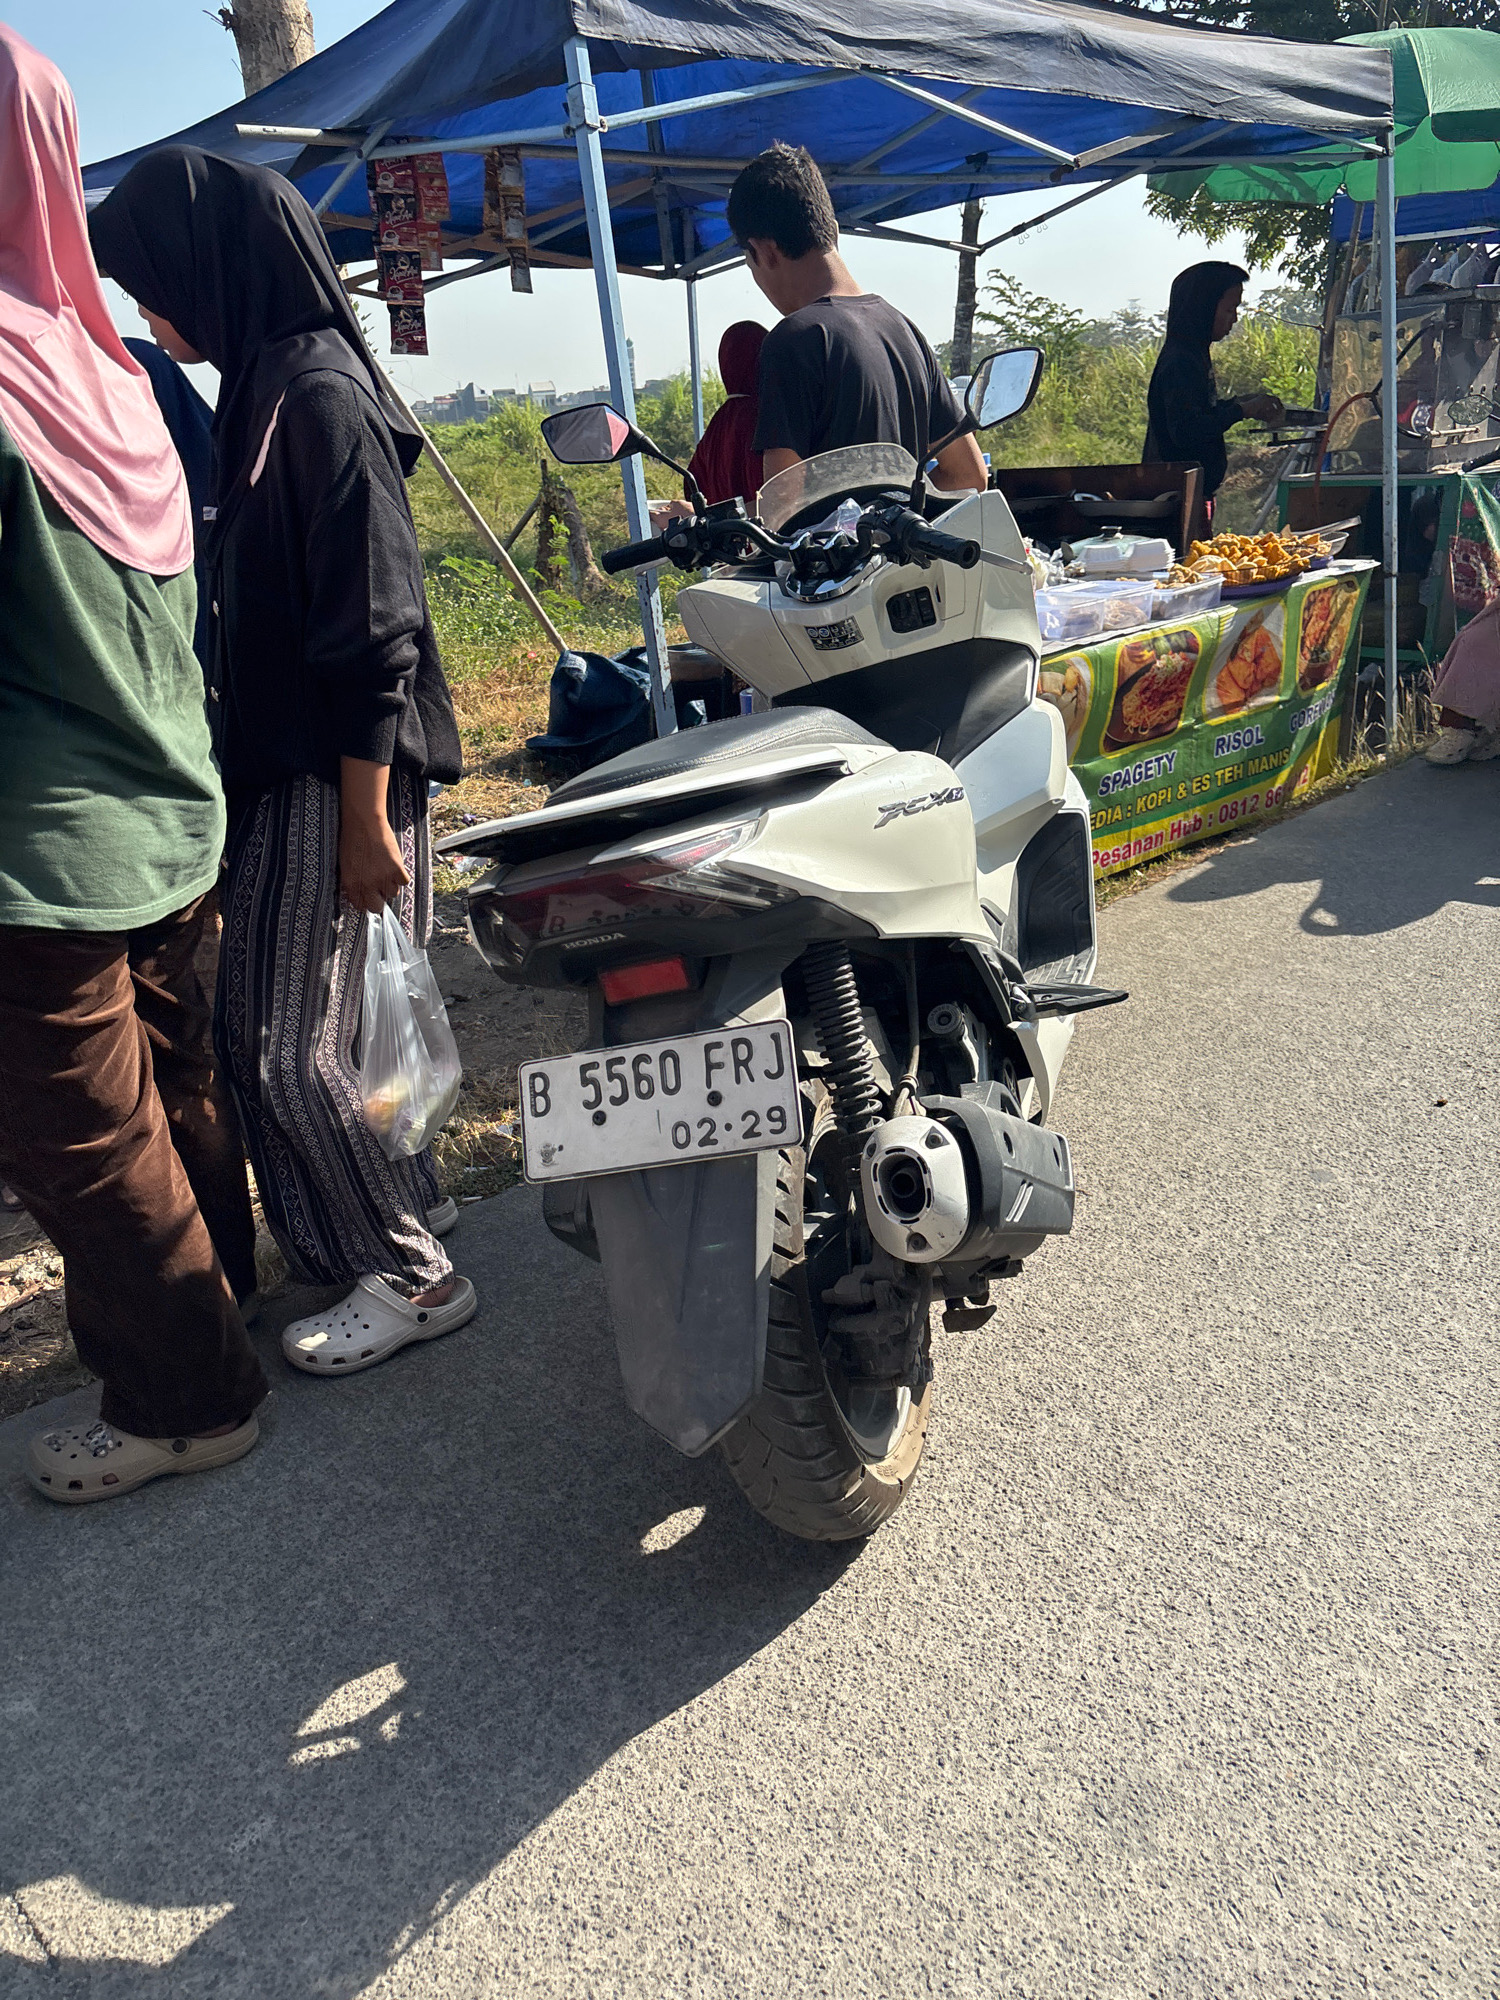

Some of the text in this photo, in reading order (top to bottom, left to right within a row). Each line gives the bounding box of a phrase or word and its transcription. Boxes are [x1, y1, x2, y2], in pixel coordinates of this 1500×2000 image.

[1214, 725, 1265, 758] RISOL
[1090, 804, 1123, 830] EDIA
[1135, 786, 1172, 815] KOPI
[1176, 781, 1187, 800] &
[1192, 773, 1211, 795] ES
[1215, 763, 1244, 788] TEH
[1248, 748, 1291, 777] MANIS
[1098, 750, 1177, 797] SPAGETY
[1093, 829, 1164, 868] Pesanan
[1169, 813, 1202, 842] Hub
[1219, 793, 1259, 824] 0812
[564, 931, 627, 950] HONDA
[529, 1031, 785, 1118] B 5560 FRJ
